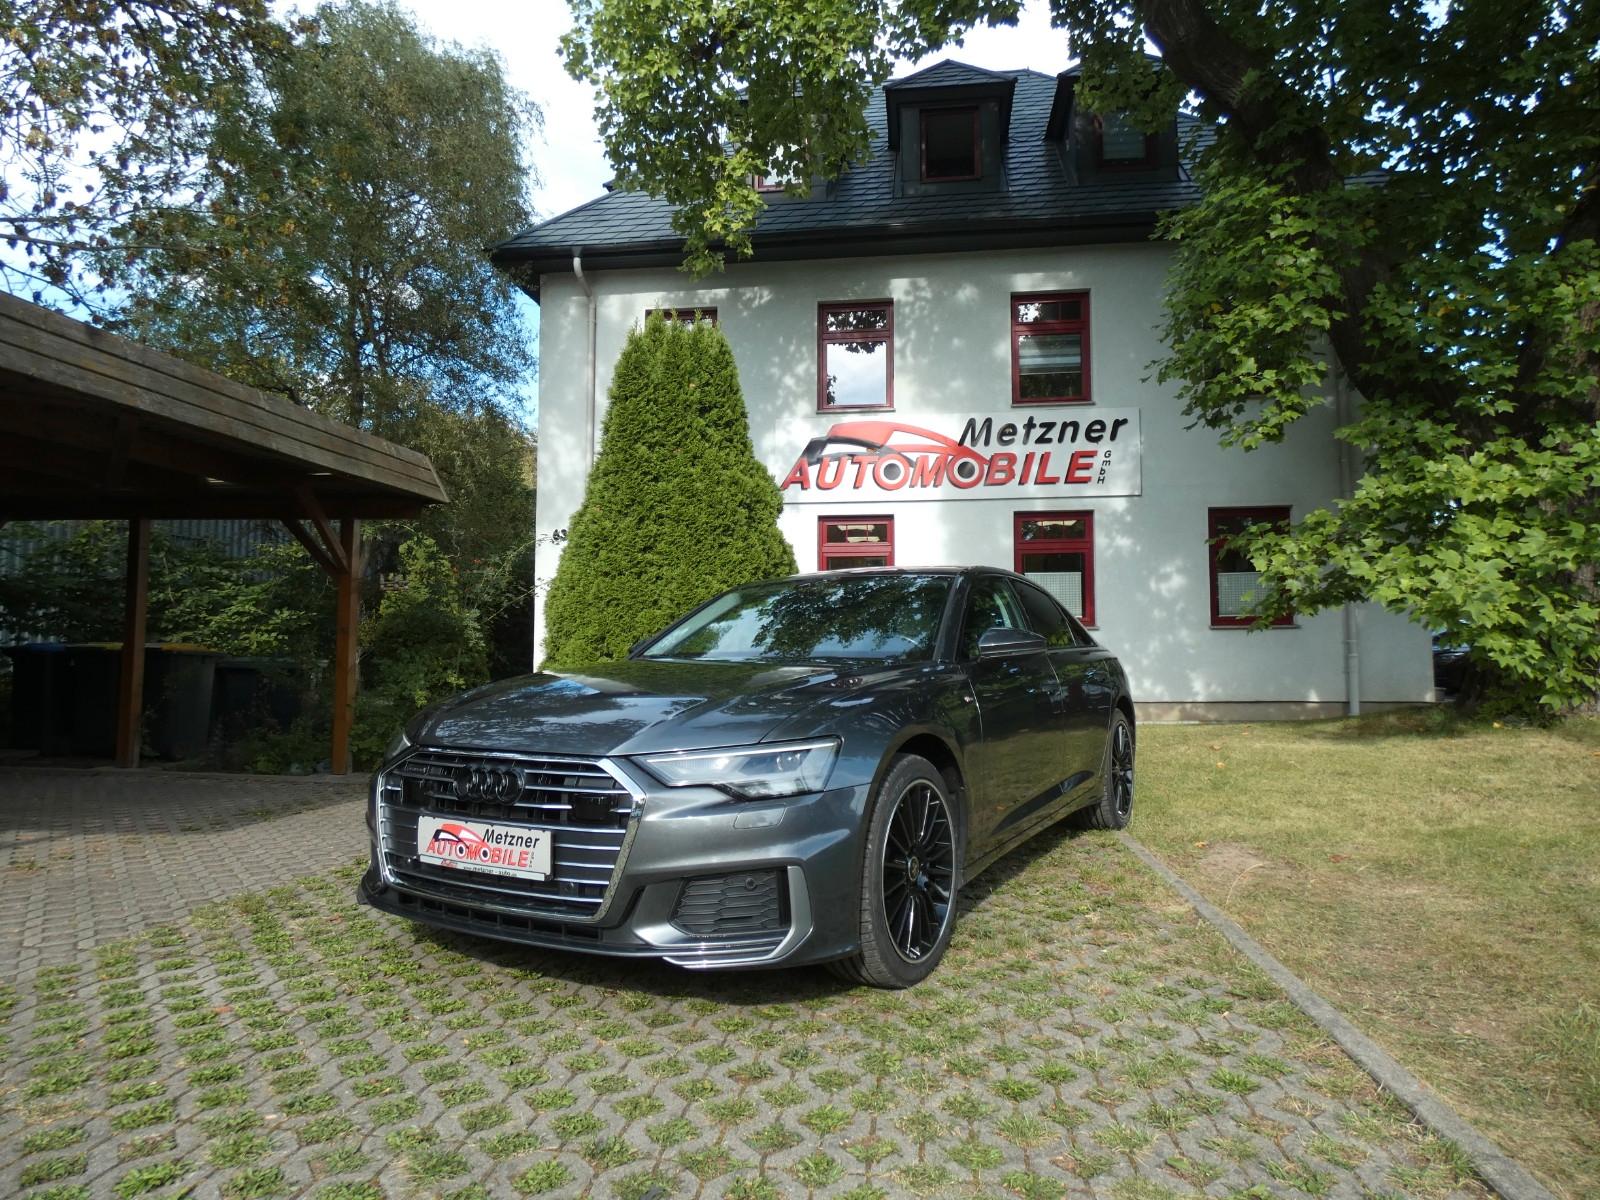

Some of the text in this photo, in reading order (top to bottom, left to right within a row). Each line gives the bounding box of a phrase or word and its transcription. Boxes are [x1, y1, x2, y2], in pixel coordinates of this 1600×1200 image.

[958, 415, 1129, 448] Metzner
[780, 449, 1099, 491] AUTOMOBILE
[1096, 450, 1112, 485] GmbH
[426, 839, 530, 868] AUTOMOBILE
[482, 828, 540, 849] Metzner
